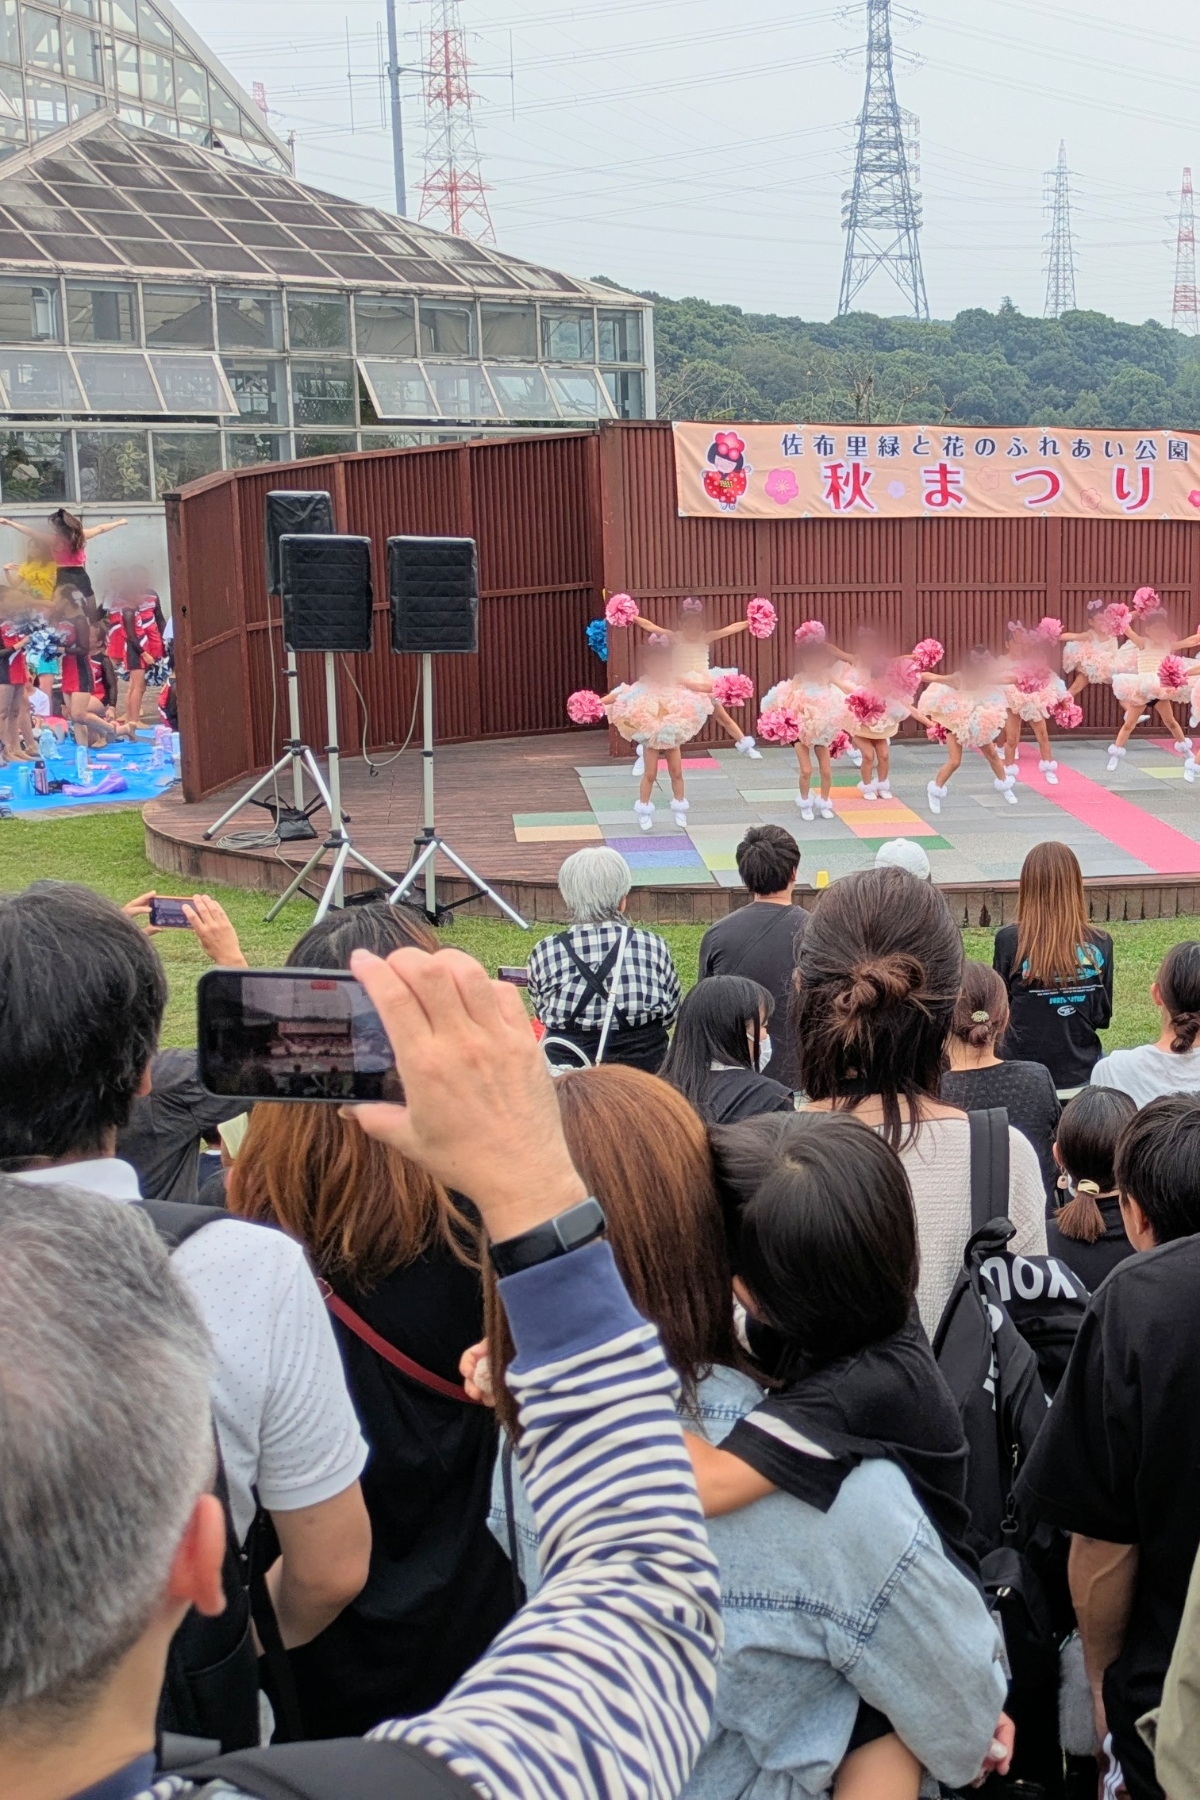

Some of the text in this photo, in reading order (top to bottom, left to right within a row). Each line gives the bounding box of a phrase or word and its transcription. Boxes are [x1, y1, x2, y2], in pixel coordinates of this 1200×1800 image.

[781, 433, 1189, 462] 佐布里緑と花のふれあい公園
[822, 461, 1151, 511] 秋まつり
